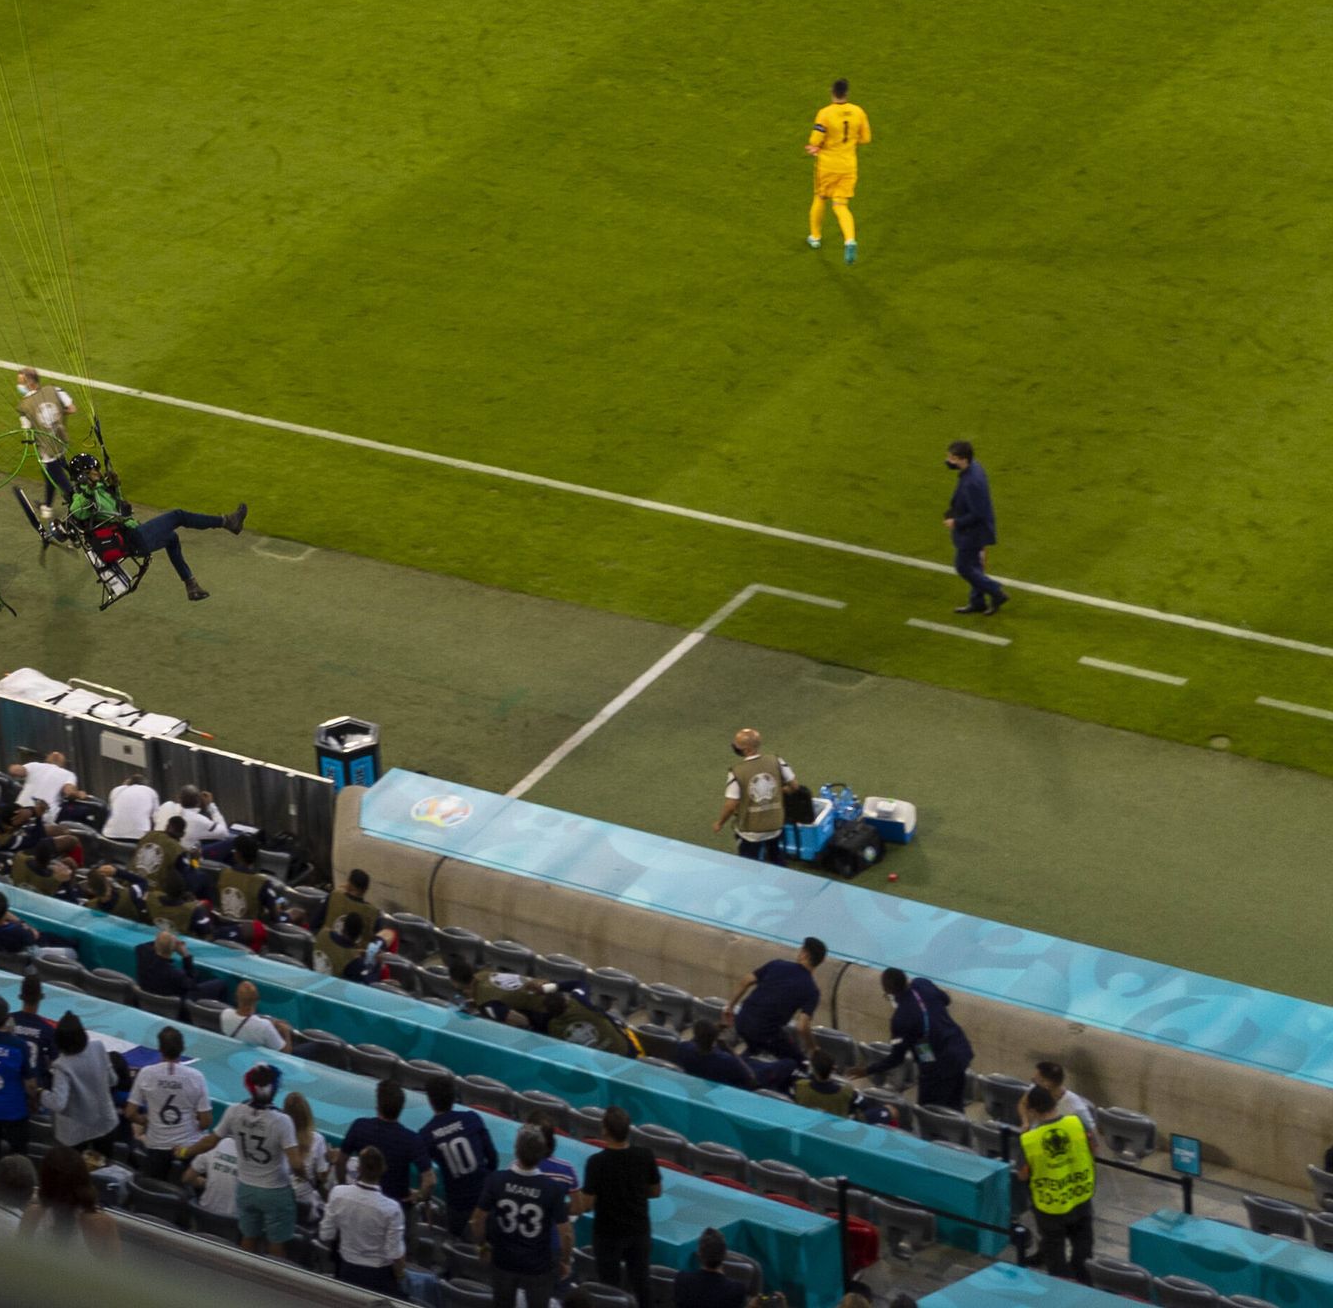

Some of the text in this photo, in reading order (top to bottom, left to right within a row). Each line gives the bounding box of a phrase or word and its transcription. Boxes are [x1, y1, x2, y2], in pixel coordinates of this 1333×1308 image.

[842, 120, 849, 144] 1
[159, 1094, 182, 1126] 6
[237, 1130, 273, 1166] 13
[437, 1136, 479, 1179] 10
[1034, 1168, 1091, 1191] STEWARD
[496, 1198, 544, 1239] 33
